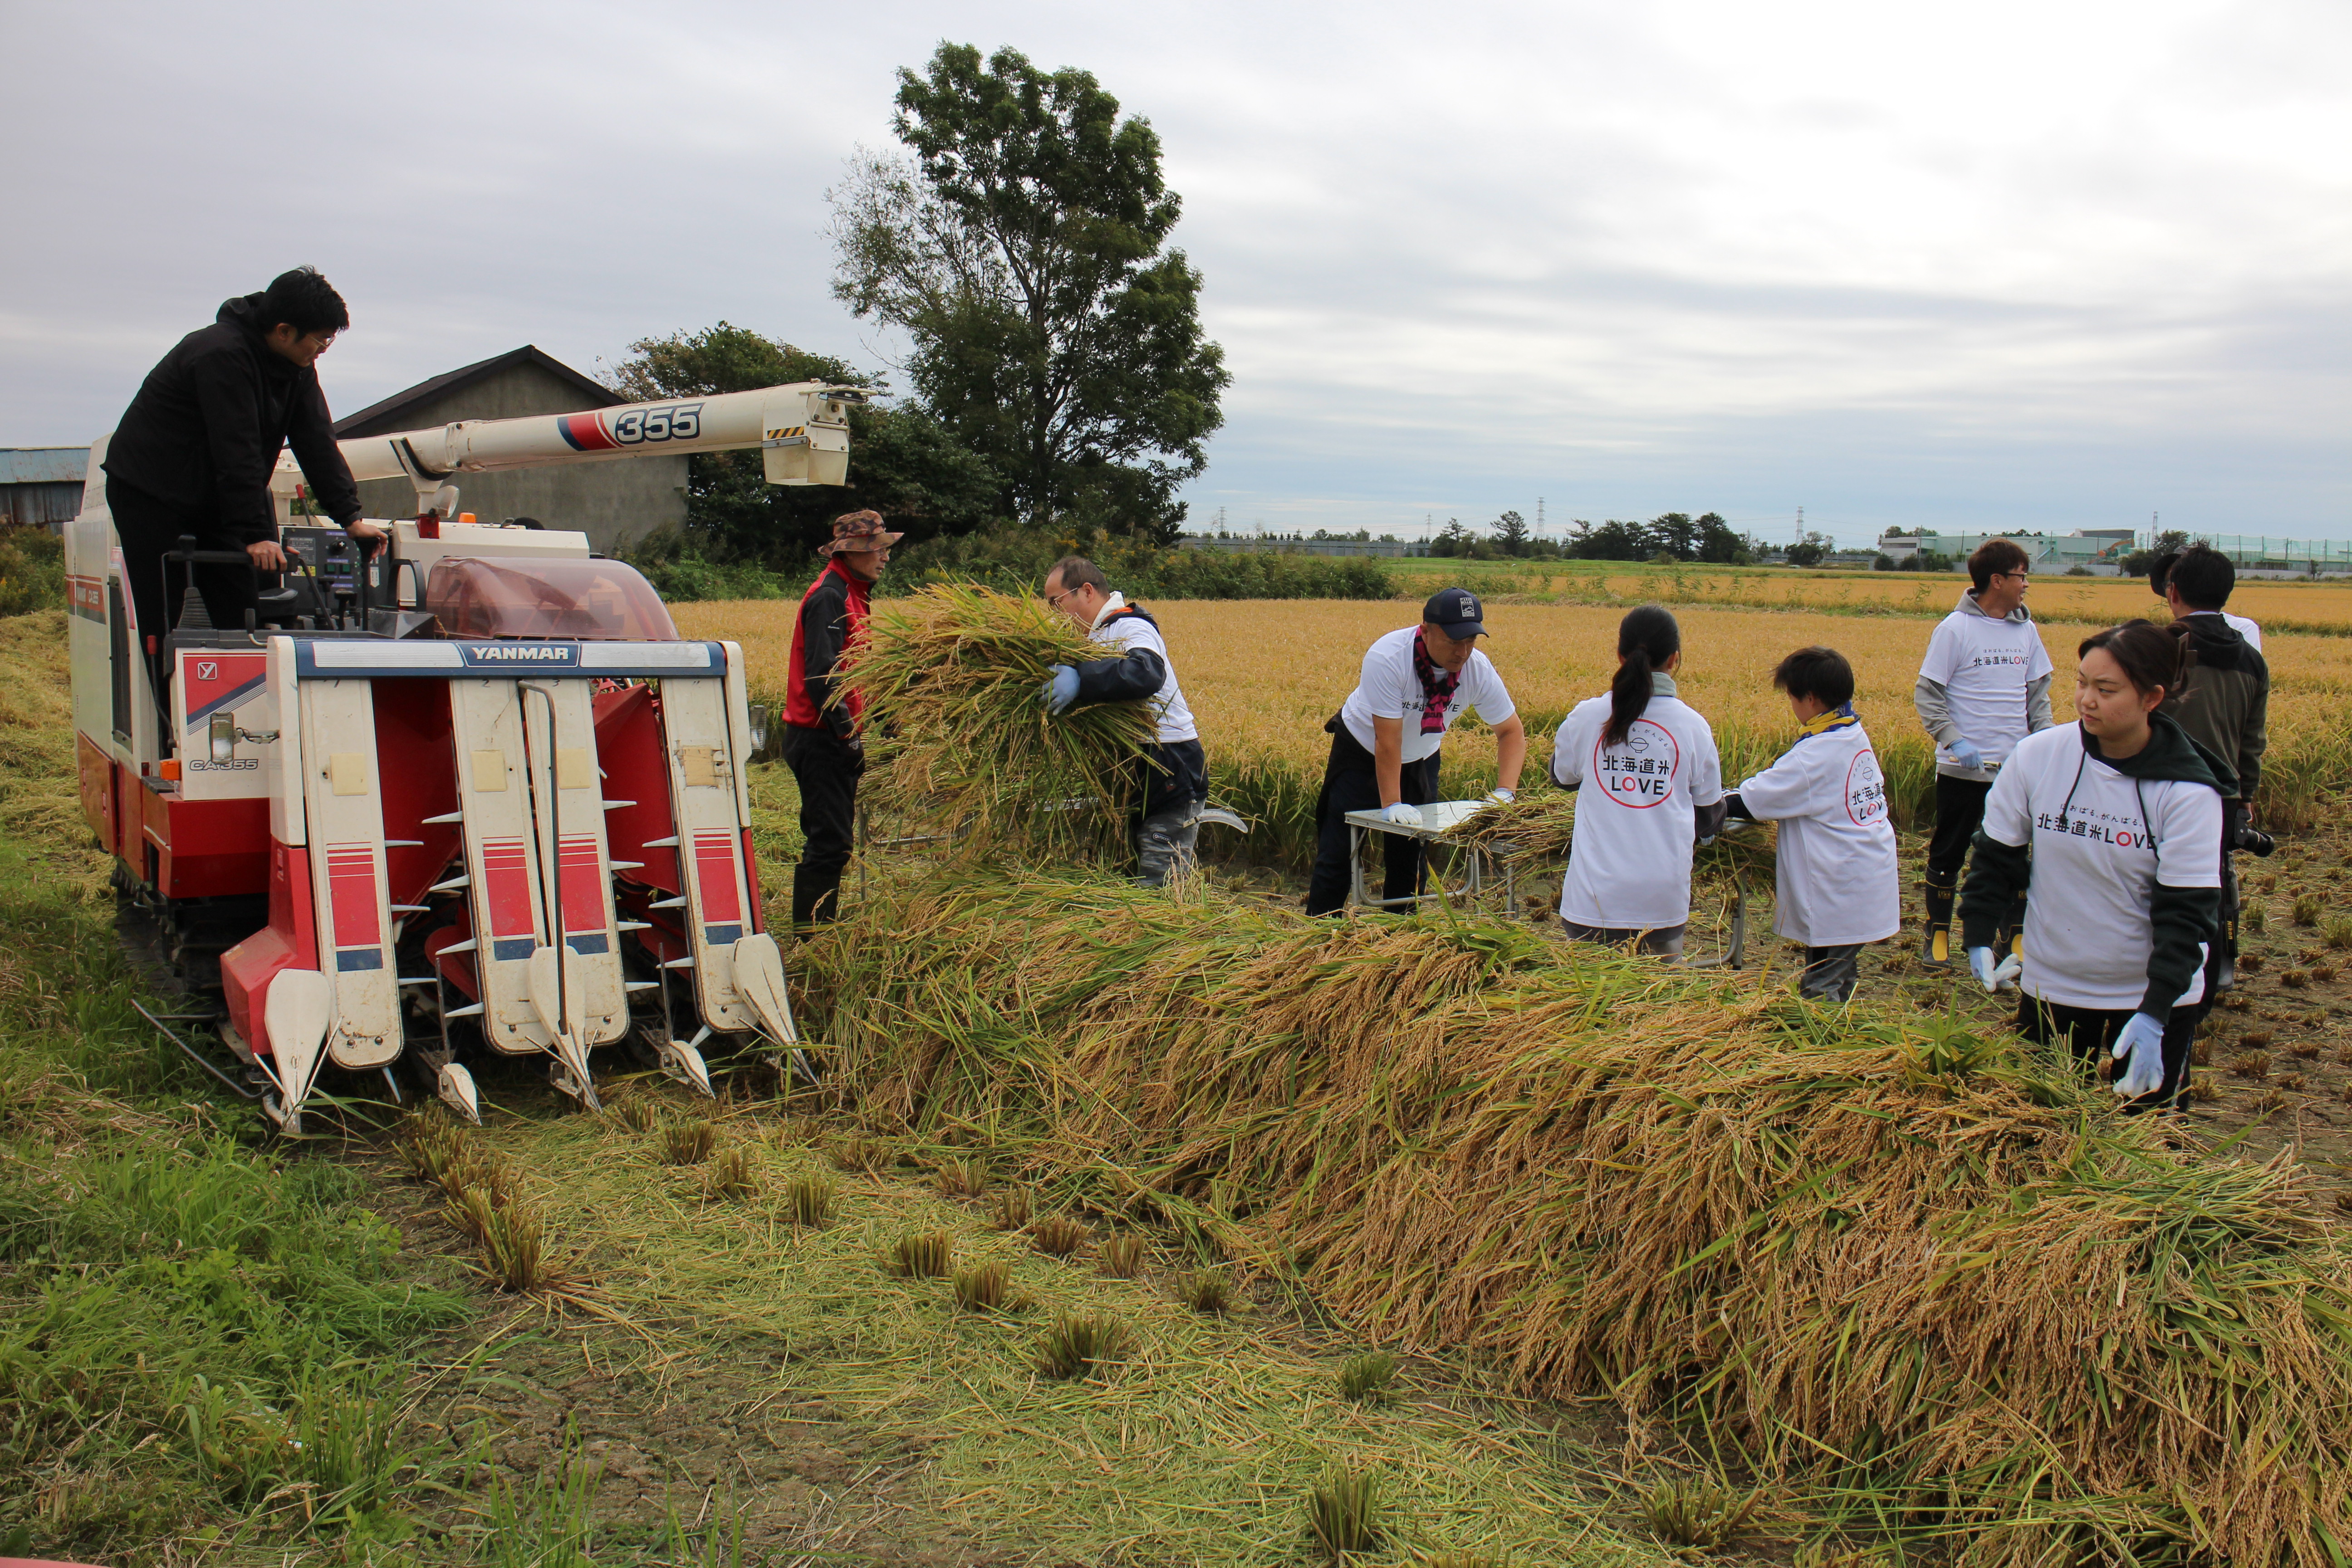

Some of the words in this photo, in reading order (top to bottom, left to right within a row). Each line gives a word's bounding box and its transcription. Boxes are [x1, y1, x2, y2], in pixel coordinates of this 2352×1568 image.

[615, 402, 706, 445] 355
[471, 647, 569, 660] YANMAR
[1603, 755, 1670, 776] 北海道米
[1612, 776, 1665, 795] LOVE
[1860, 799, 1883, 820] LOV
